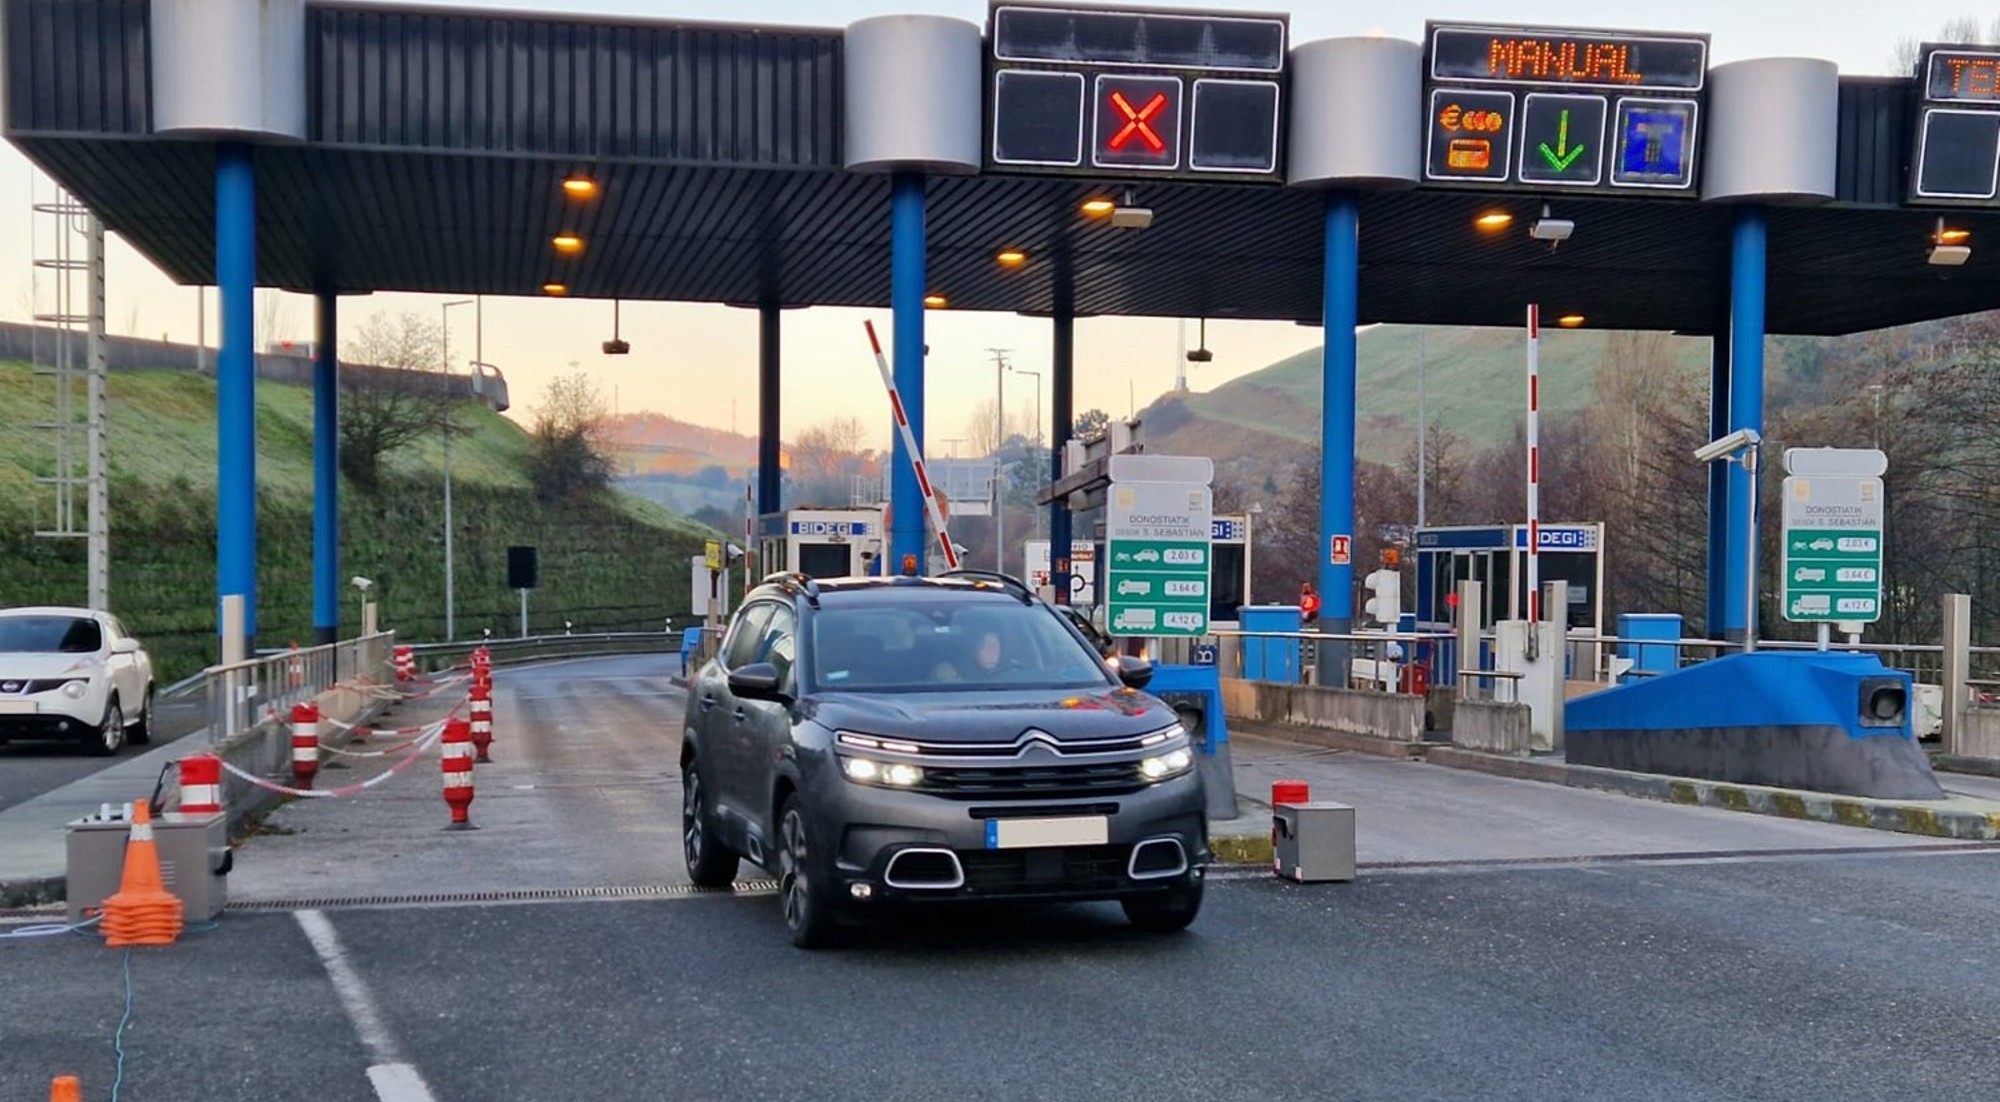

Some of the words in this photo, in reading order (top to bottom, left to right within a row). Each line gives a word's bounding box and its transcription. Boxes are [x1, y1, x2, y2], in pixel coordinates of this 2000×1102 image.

[1490, 39, 1641, 79] MANUAL
[1947, 59, 2000, 92] TE
[800, 522, 852, 534] BIDEGI
